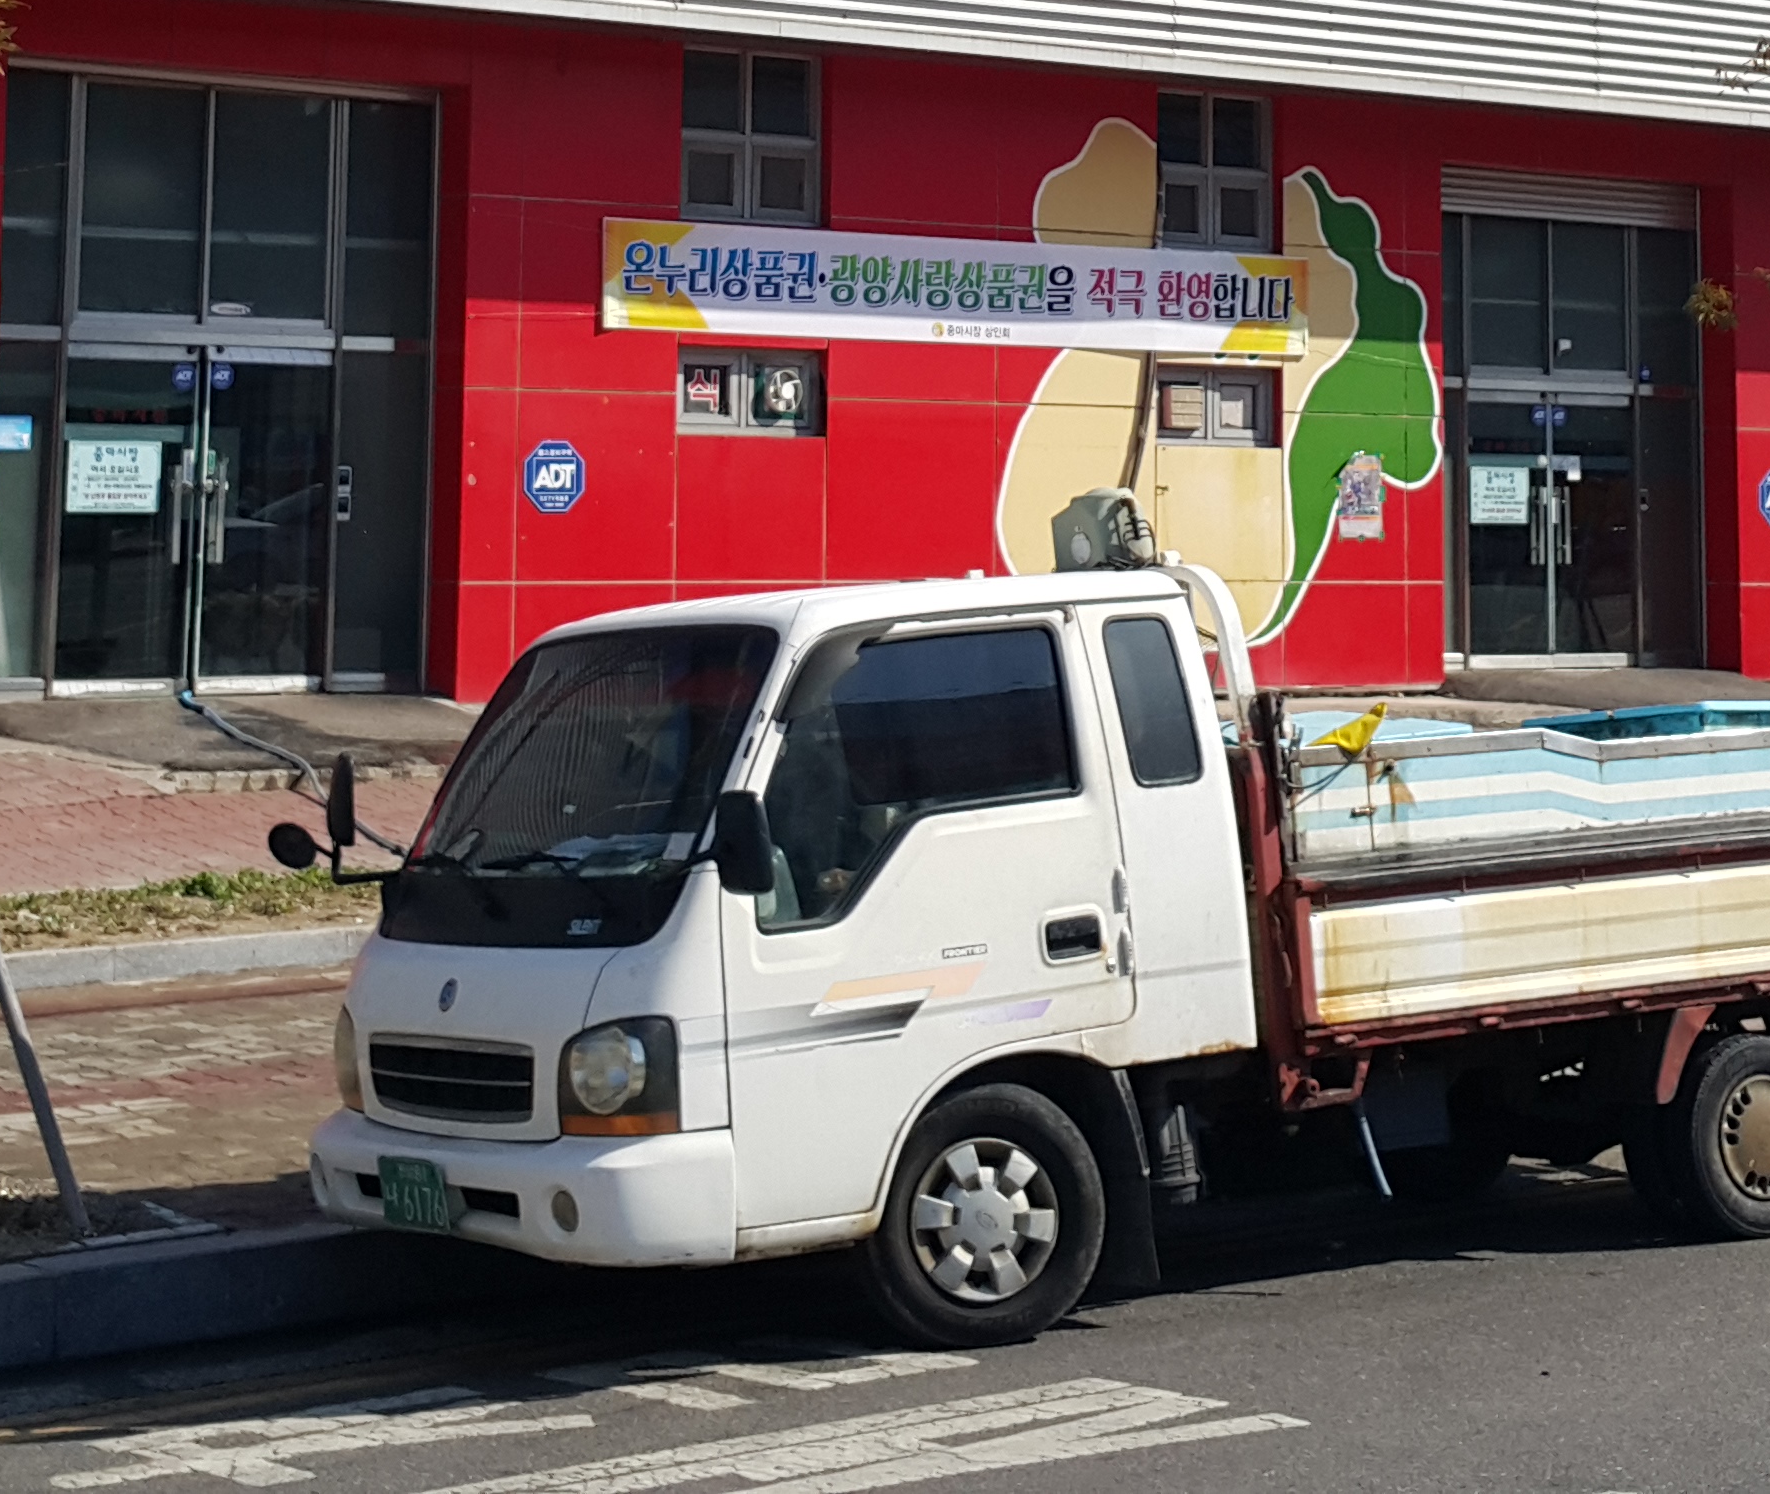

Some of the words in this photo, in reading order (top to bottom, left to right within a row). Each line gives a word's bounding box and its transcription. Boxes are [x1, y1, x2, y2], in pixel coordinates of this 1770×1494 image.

[1085, 266, 1148, 317] 적극
[1156, 269, 1295, 322] 환영합니다
[947, 324, 981, 339] 중마시장
[533, 462, 577, 490] ADT
